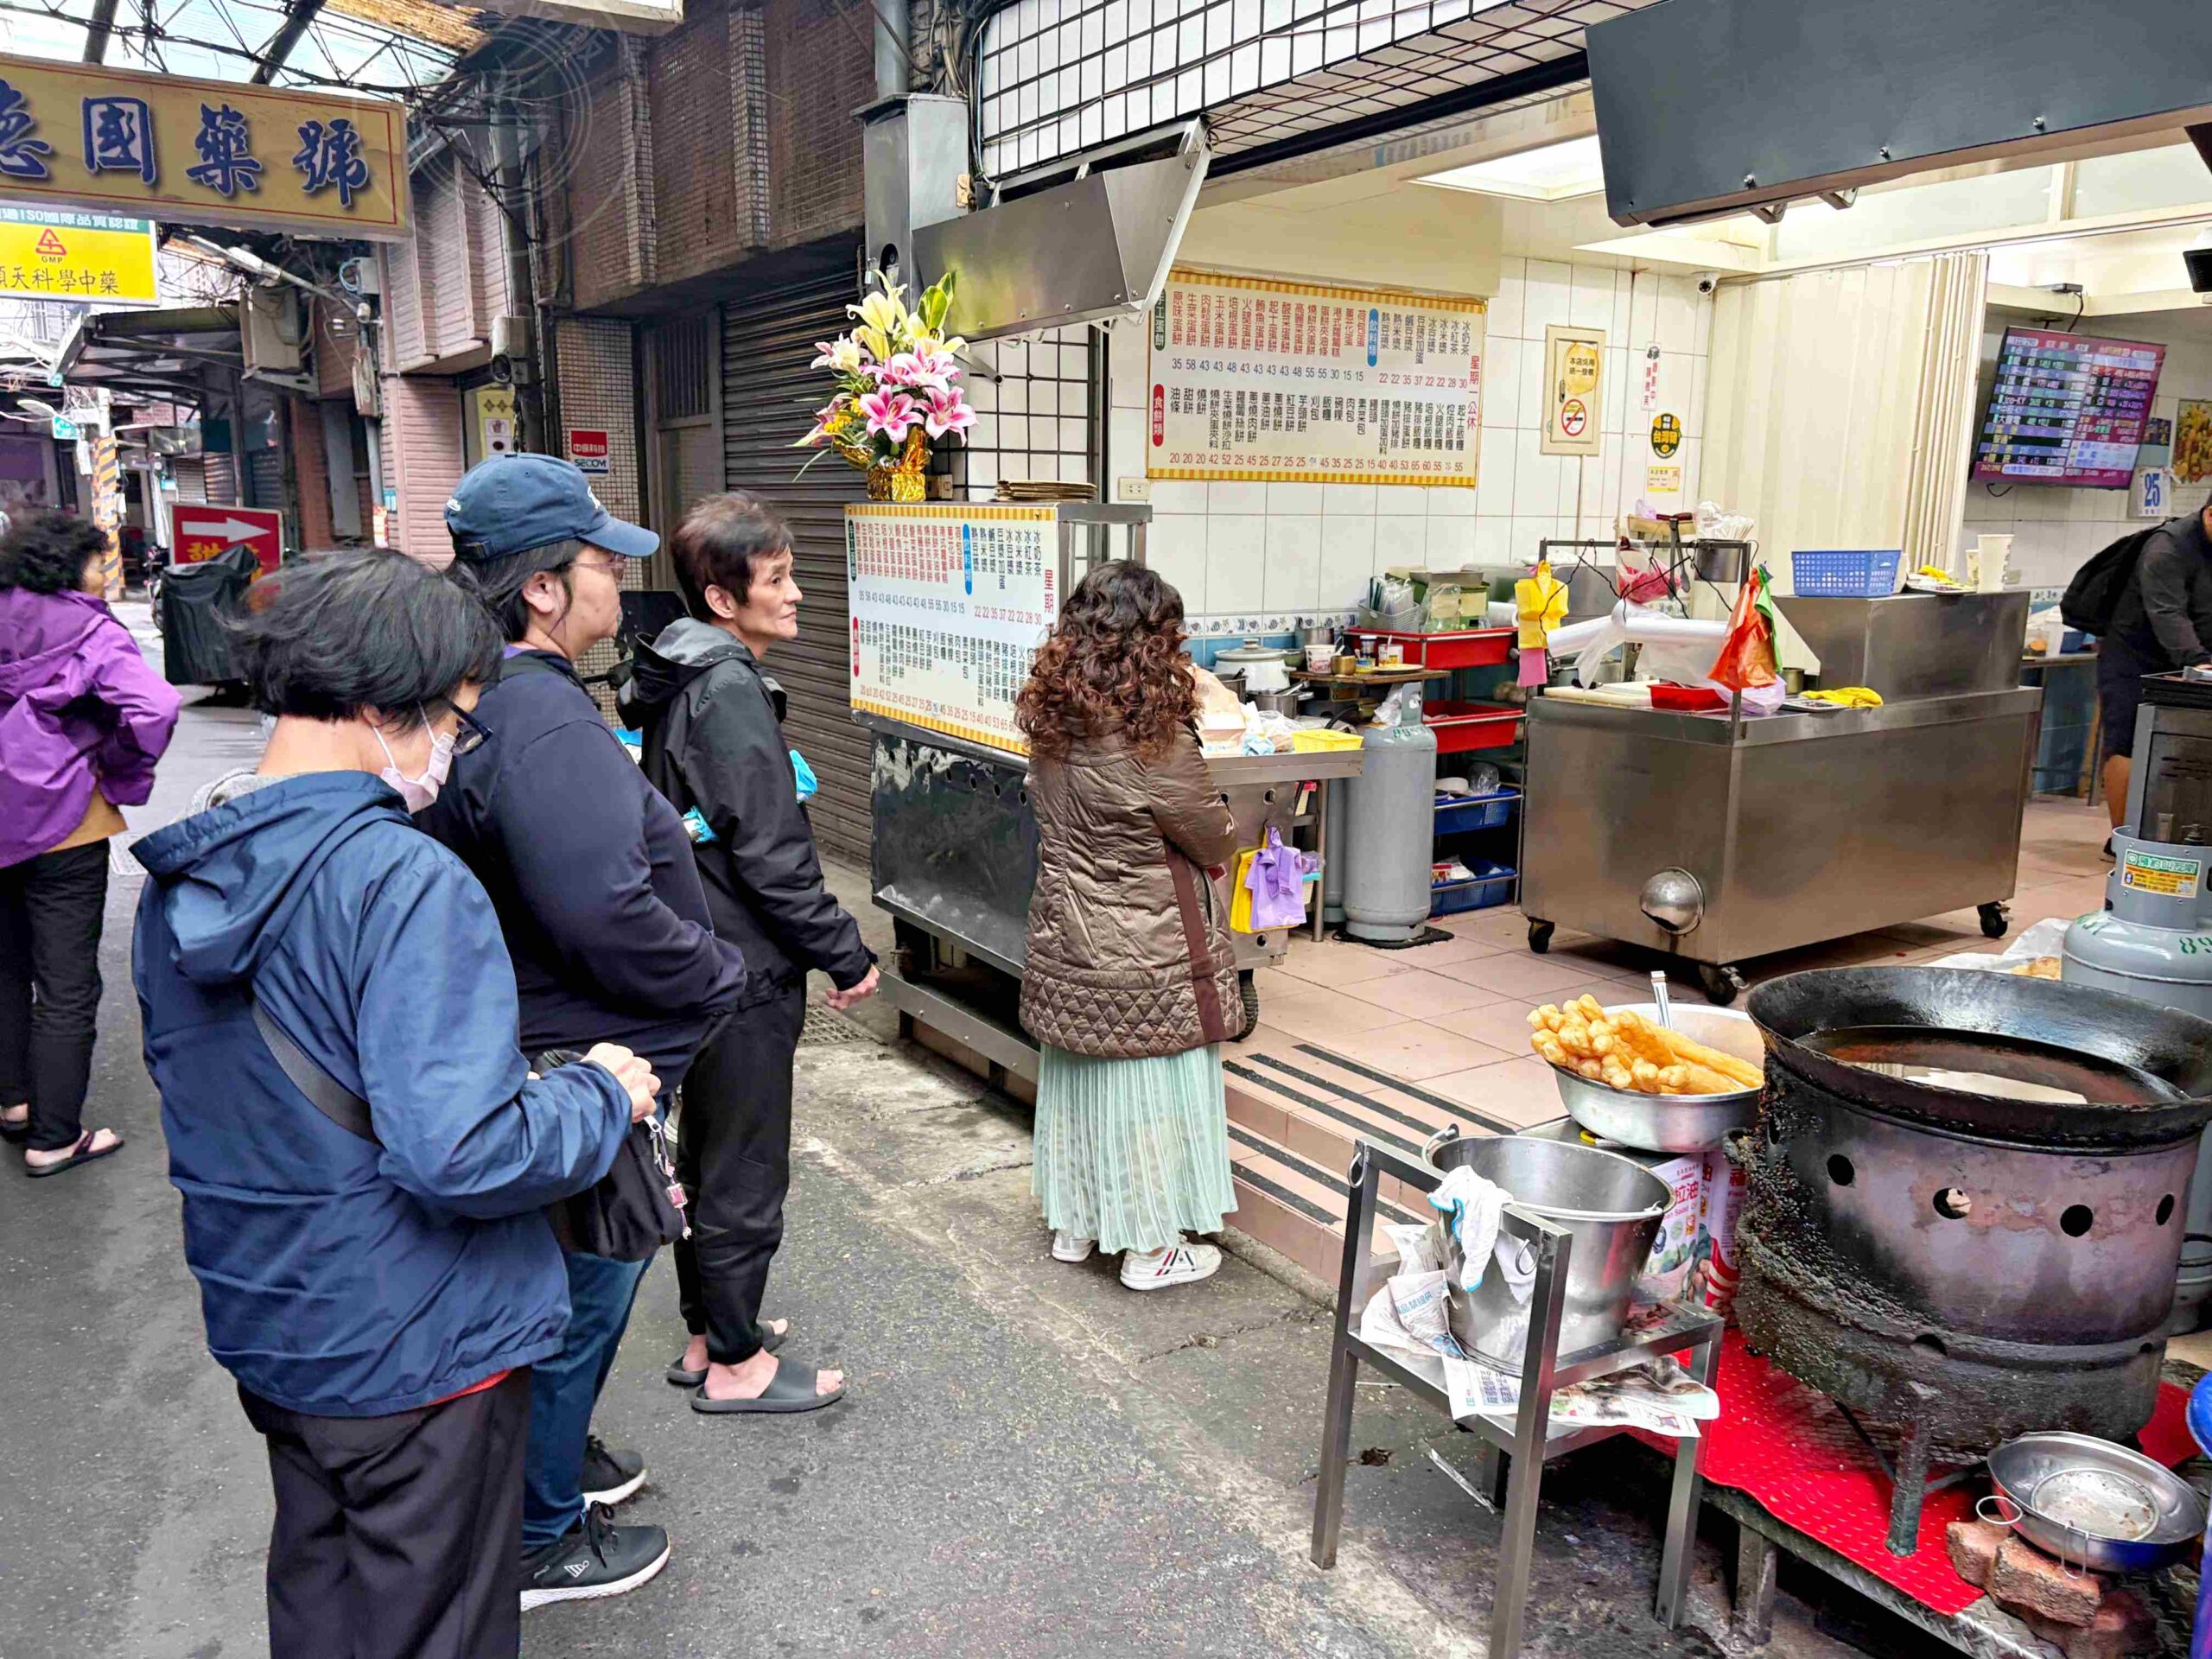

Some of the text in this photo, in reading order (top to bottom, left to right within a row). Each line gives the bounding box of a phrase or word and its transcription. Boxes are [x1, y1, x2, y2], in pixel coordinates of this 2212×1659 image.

[41, 256, 63, 264] GMP
[1172, 291, 1183, 346] 原味蛋餅
[1185, 292, 1197, 346] 生菜蛋餅
[1214, 296, 1225, 348] 玉米蛋餅
[1228, 297, 1239, 350] 培根蛋餅
[1241, 298, 1252, 351] 火腿蛋餅
[1268, 300, 1278, 353] 起士蛋餅
[1357, 309, 1366, 347] 荷包蛋
[1427, 317, 1437, 353] 冰豆漿
[1439, 318, 1448, 354] 冰米漿
[1450, 320, 1459, 355] 冰紅茶
[1461, 321, 1470, 356] 冰奶茶
[1172, 359, 1363, 381] 35 58 43 43 48 43 43 43 43 48 55 55 30 15 15
[1379, 373, 1467, 389] 22 22 35 37 22 22 28 30
[1170, 387, 1180, 414] 油條
[1183, 388, 1193, 415] 甜餅
[1197, 389, 1207, 415] 燒餅
[1311, 396, 1319, 421] 刈包
[1346, 397, 1355, 423] 肉包
[1467, 355, 1479, 429] 星期一公休
[1209, 390, 1220, 450] 燒餅夾蛋夾料
[1222, 391, 1232, 450] 生菜燒餅沙拉
[1285, 394, 1295, 432] 紅豆餅
[1297, 396, 1307, 433] 芋頭餅
[1357, 398, 1366, 435] 素菜包
[575, 459, 607, 467] SECOM
[1170, 453, 1179, 463] 20
[1183, 453, 1192, 463] 20
[1196, 454, 1205, 464] 20
[1209, 454, 1218, 464] 42
[1222, 454, 1231, 464] 52
[1235, 454, 1243, 465] 25
[1247, 455, 1256, 465] 45
[1259, 456, 1268, 466] 25
[1272, 456, 1281, 466] 27
[1284, 457, 1294, 467] 25
[1297, 457, 1306, 467] 25
[1320, 458, 1329, 467] 45
[1332, 459, 1340, 467] 35
[1344, 459, 1352, 468] 25
[1355, 460, 1363, 468] 25
[1367, 460, 1375, 468] 15
[1378, 460, 1387, 469] 40
[1389, 461, 1398, 469] 40
[1411, 461, 1420, 470] 65
[1422, 461, 1431, 470] 60
[1433, 462, 1441, 471] 55
[1455, 462, 1463, 471] 55
[2145, 473, 2160, 507] 25
[1024, 528, 1033, 576] 冰紅茶
